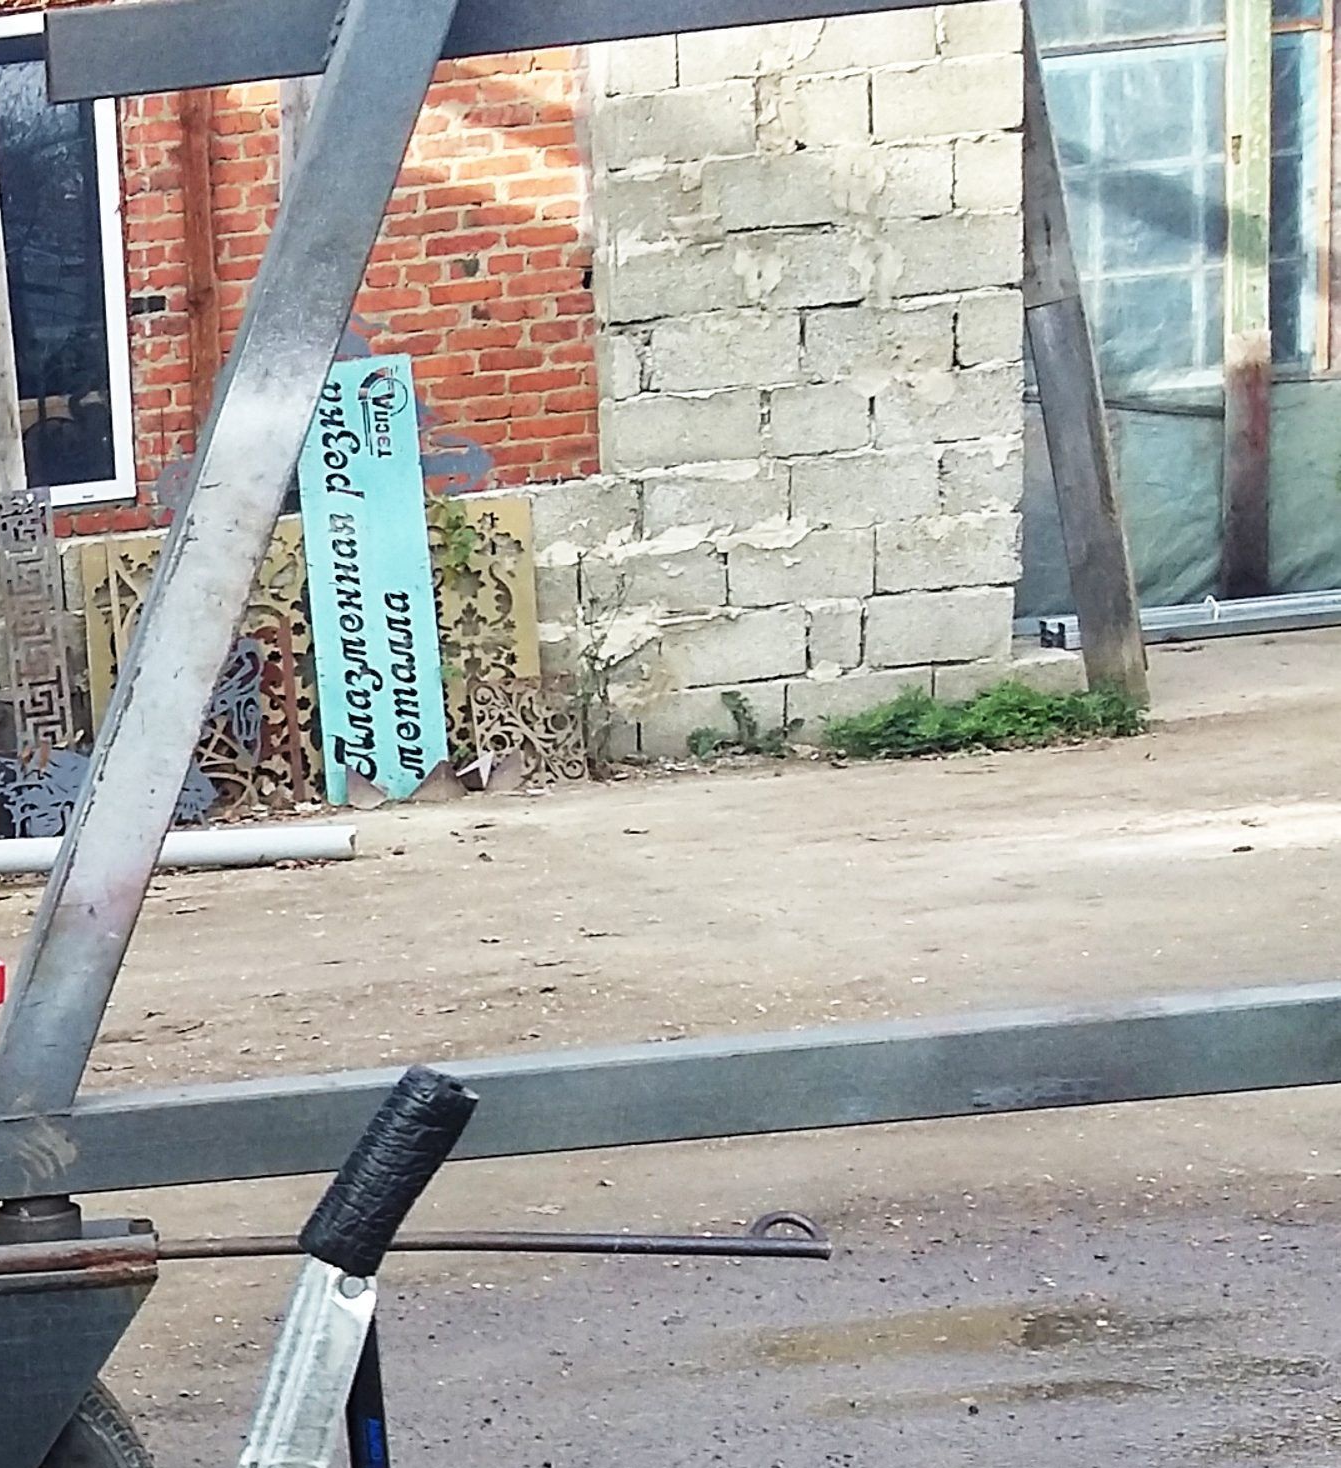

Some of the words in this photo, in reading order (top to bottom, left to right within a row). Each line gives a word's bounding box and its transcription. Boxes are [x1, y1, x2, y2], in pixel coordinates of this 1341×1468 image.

[319, 380, 366, 499] резка
[372, 392, 396, 459] ТЭСПА
[328, 512, 384, 783] Плазменная
[383, 590, 427, 780] металла
